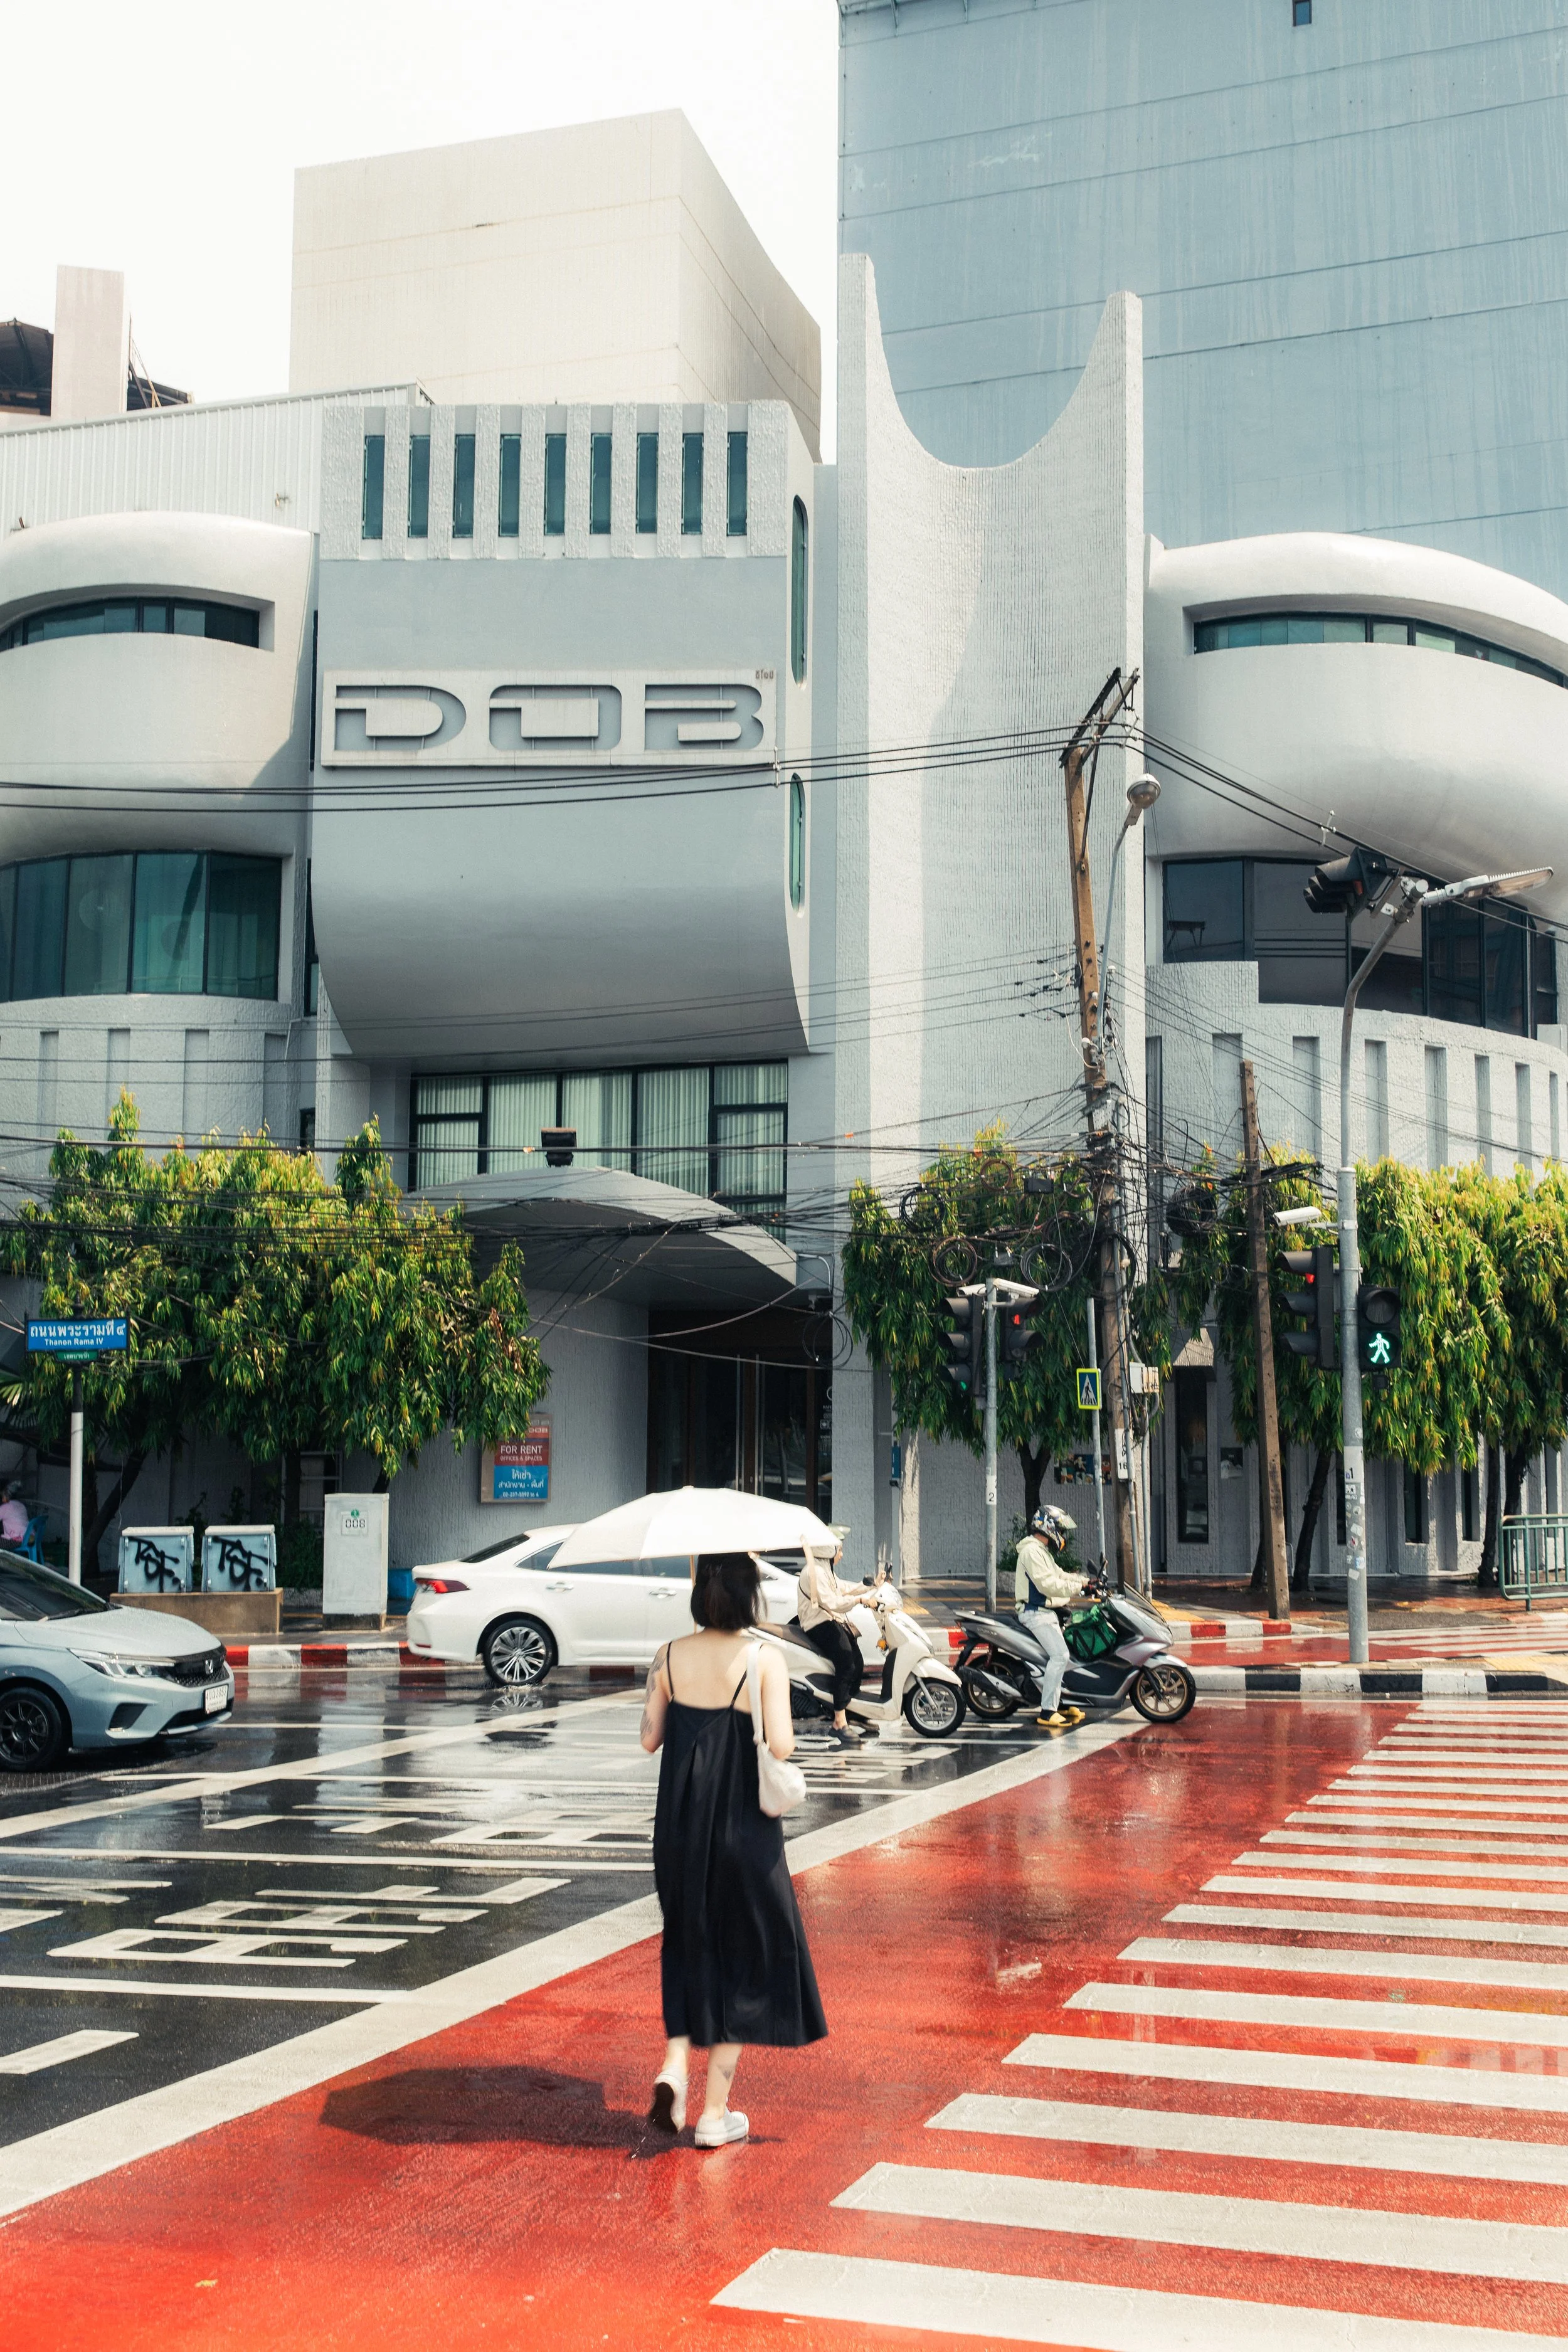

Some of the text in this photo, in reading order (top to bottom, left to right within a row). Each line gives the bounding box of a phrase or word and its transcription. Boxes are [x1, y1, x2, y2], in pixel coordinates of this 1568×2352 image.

[334, 683, 765, 751] DOB
[30, 1320, 126, 1337] ถนนพระรามที่ ๔
[45, 1337, 103, 1346] Thanon Rama IV
[501, 1444, 543, 1454] FOR RENT
[511, 1468, 531, 1480] ให้เช่า
[498, 1480, 526, 1489] สำนักงาน
[531, 1478, 544, 1489] พื้นที่
[988, 1491, 995, 1502] 2
[346, 1518, 365, 1528] 008
